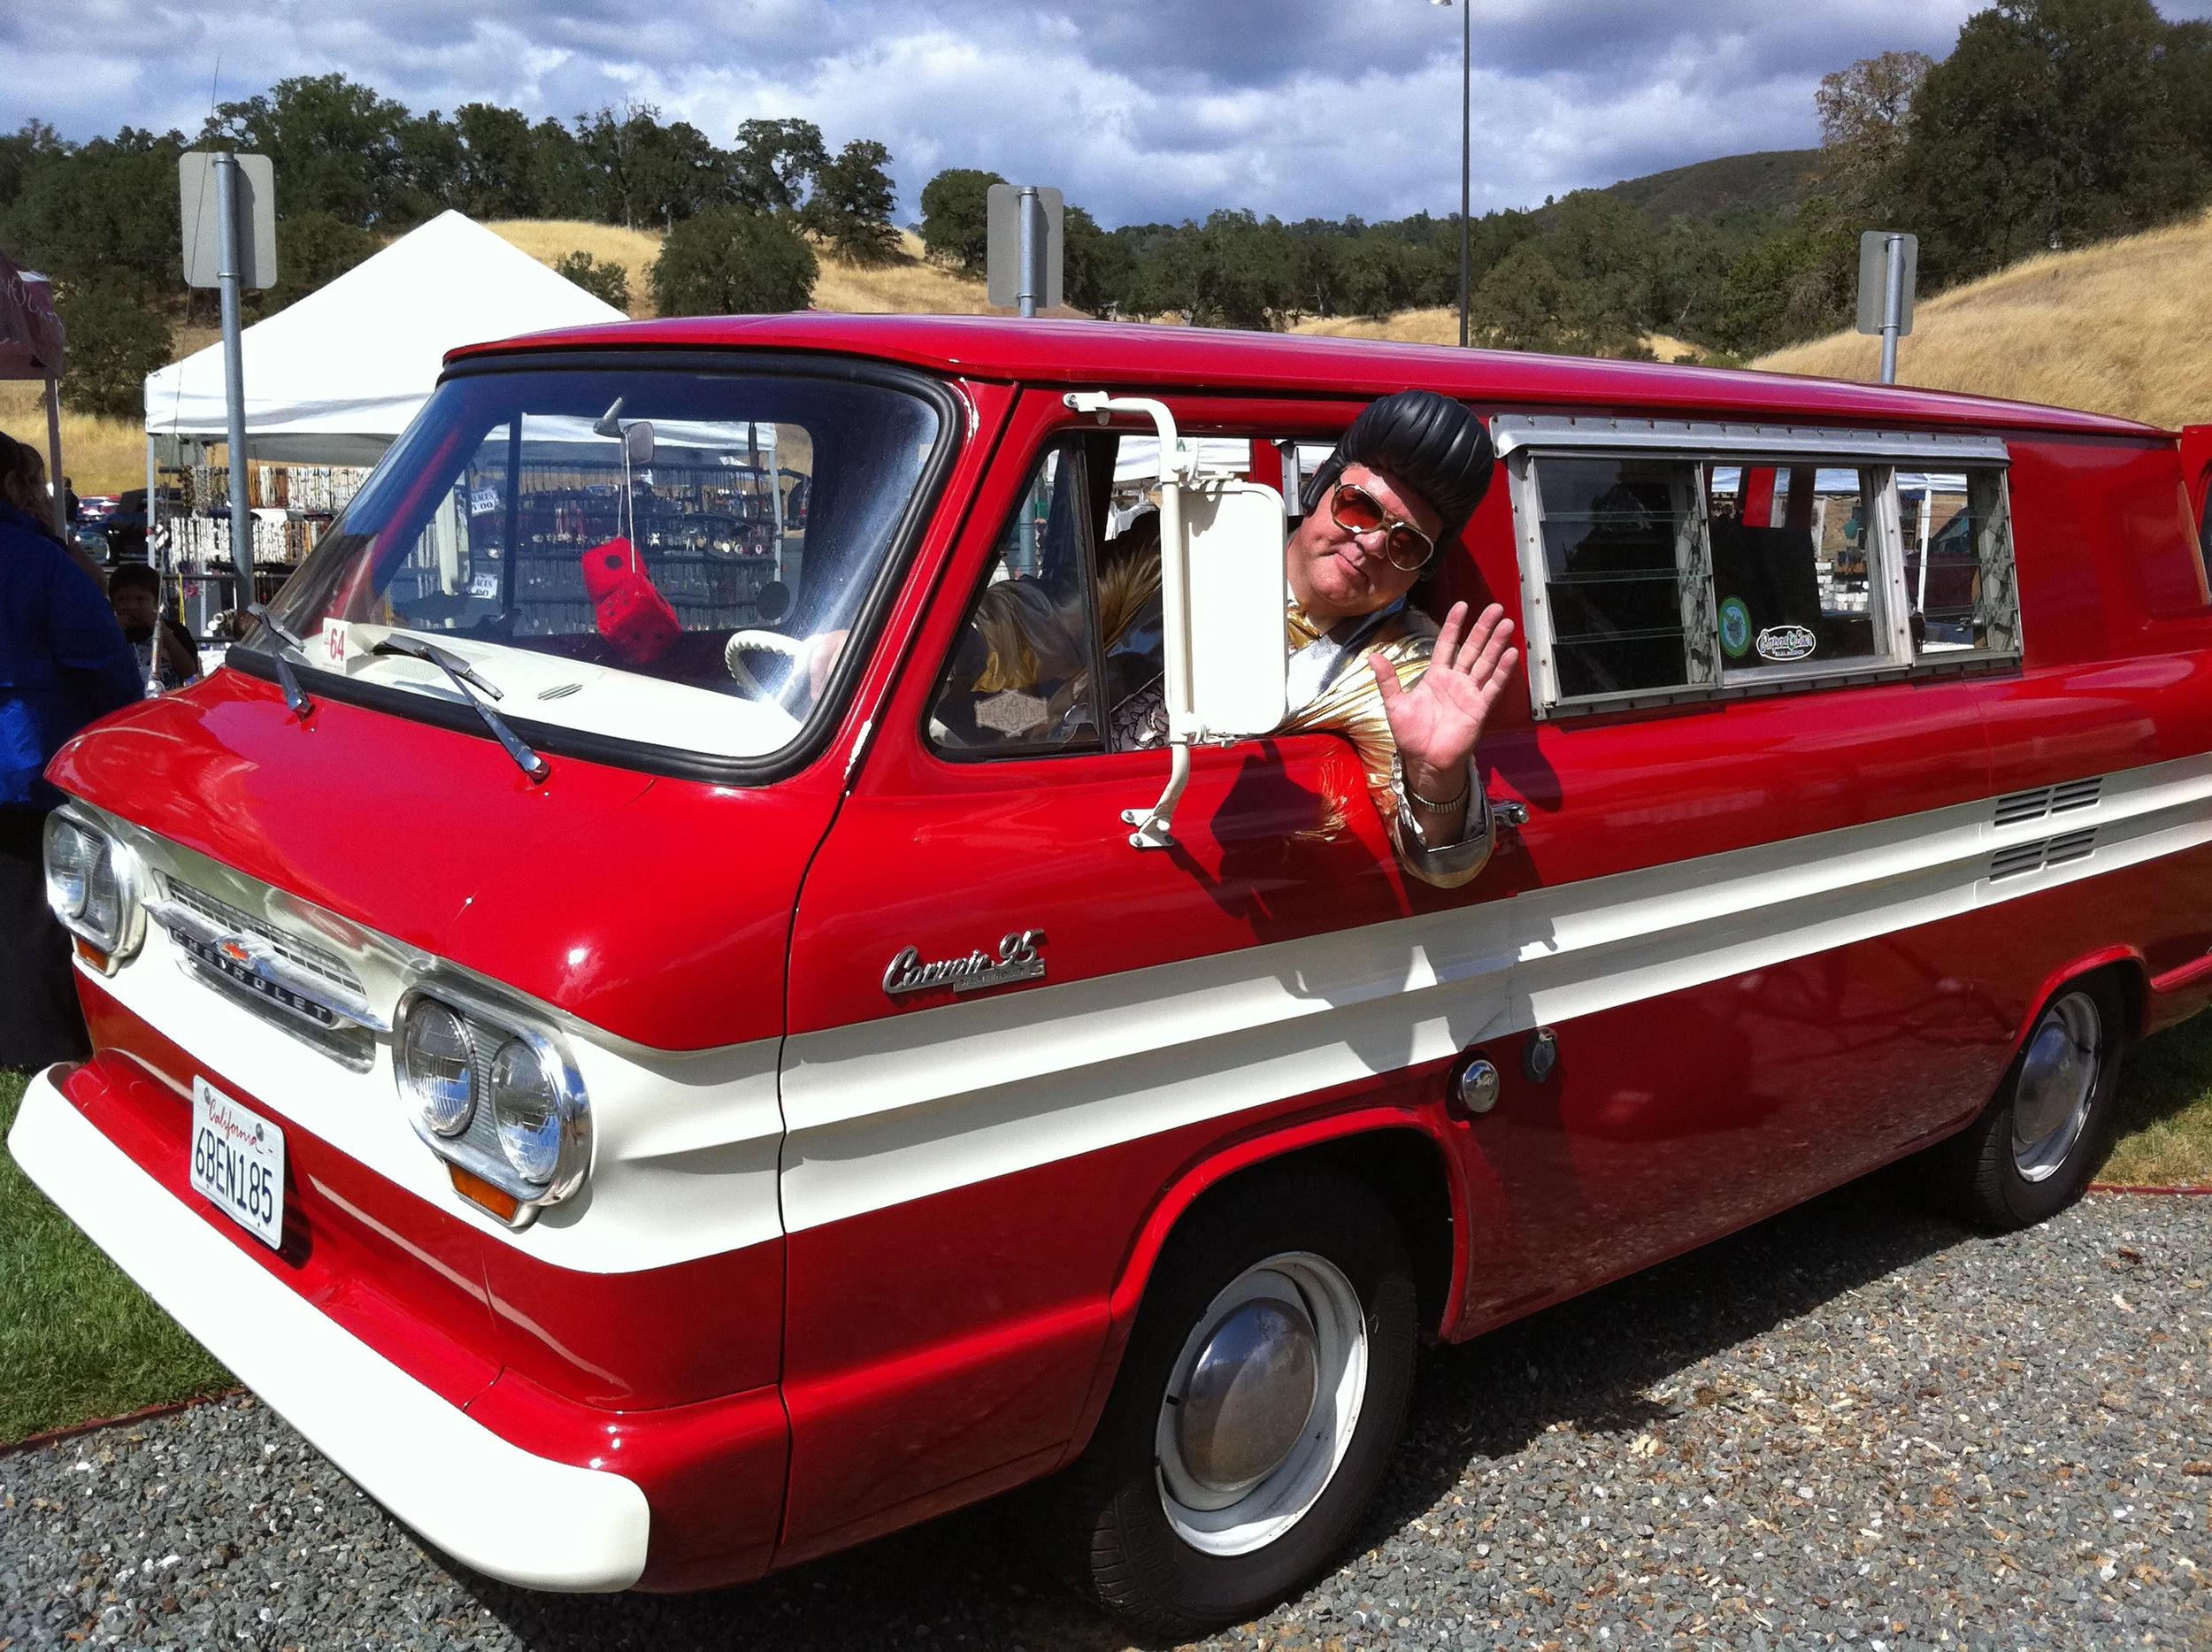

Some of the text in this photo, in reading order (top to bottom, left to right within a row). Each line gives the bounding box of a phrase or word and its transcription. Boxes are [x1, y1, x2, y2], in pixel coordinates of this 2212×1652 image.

[330, 628, 345, 662] 64
[173, 932, 326, 1018] CHEVROLET
[882, 928, 1045, 994] Corvair 95
[208, 1099, 264, 1154] California
[196, 1126, 273, 1225] 6BEN185
